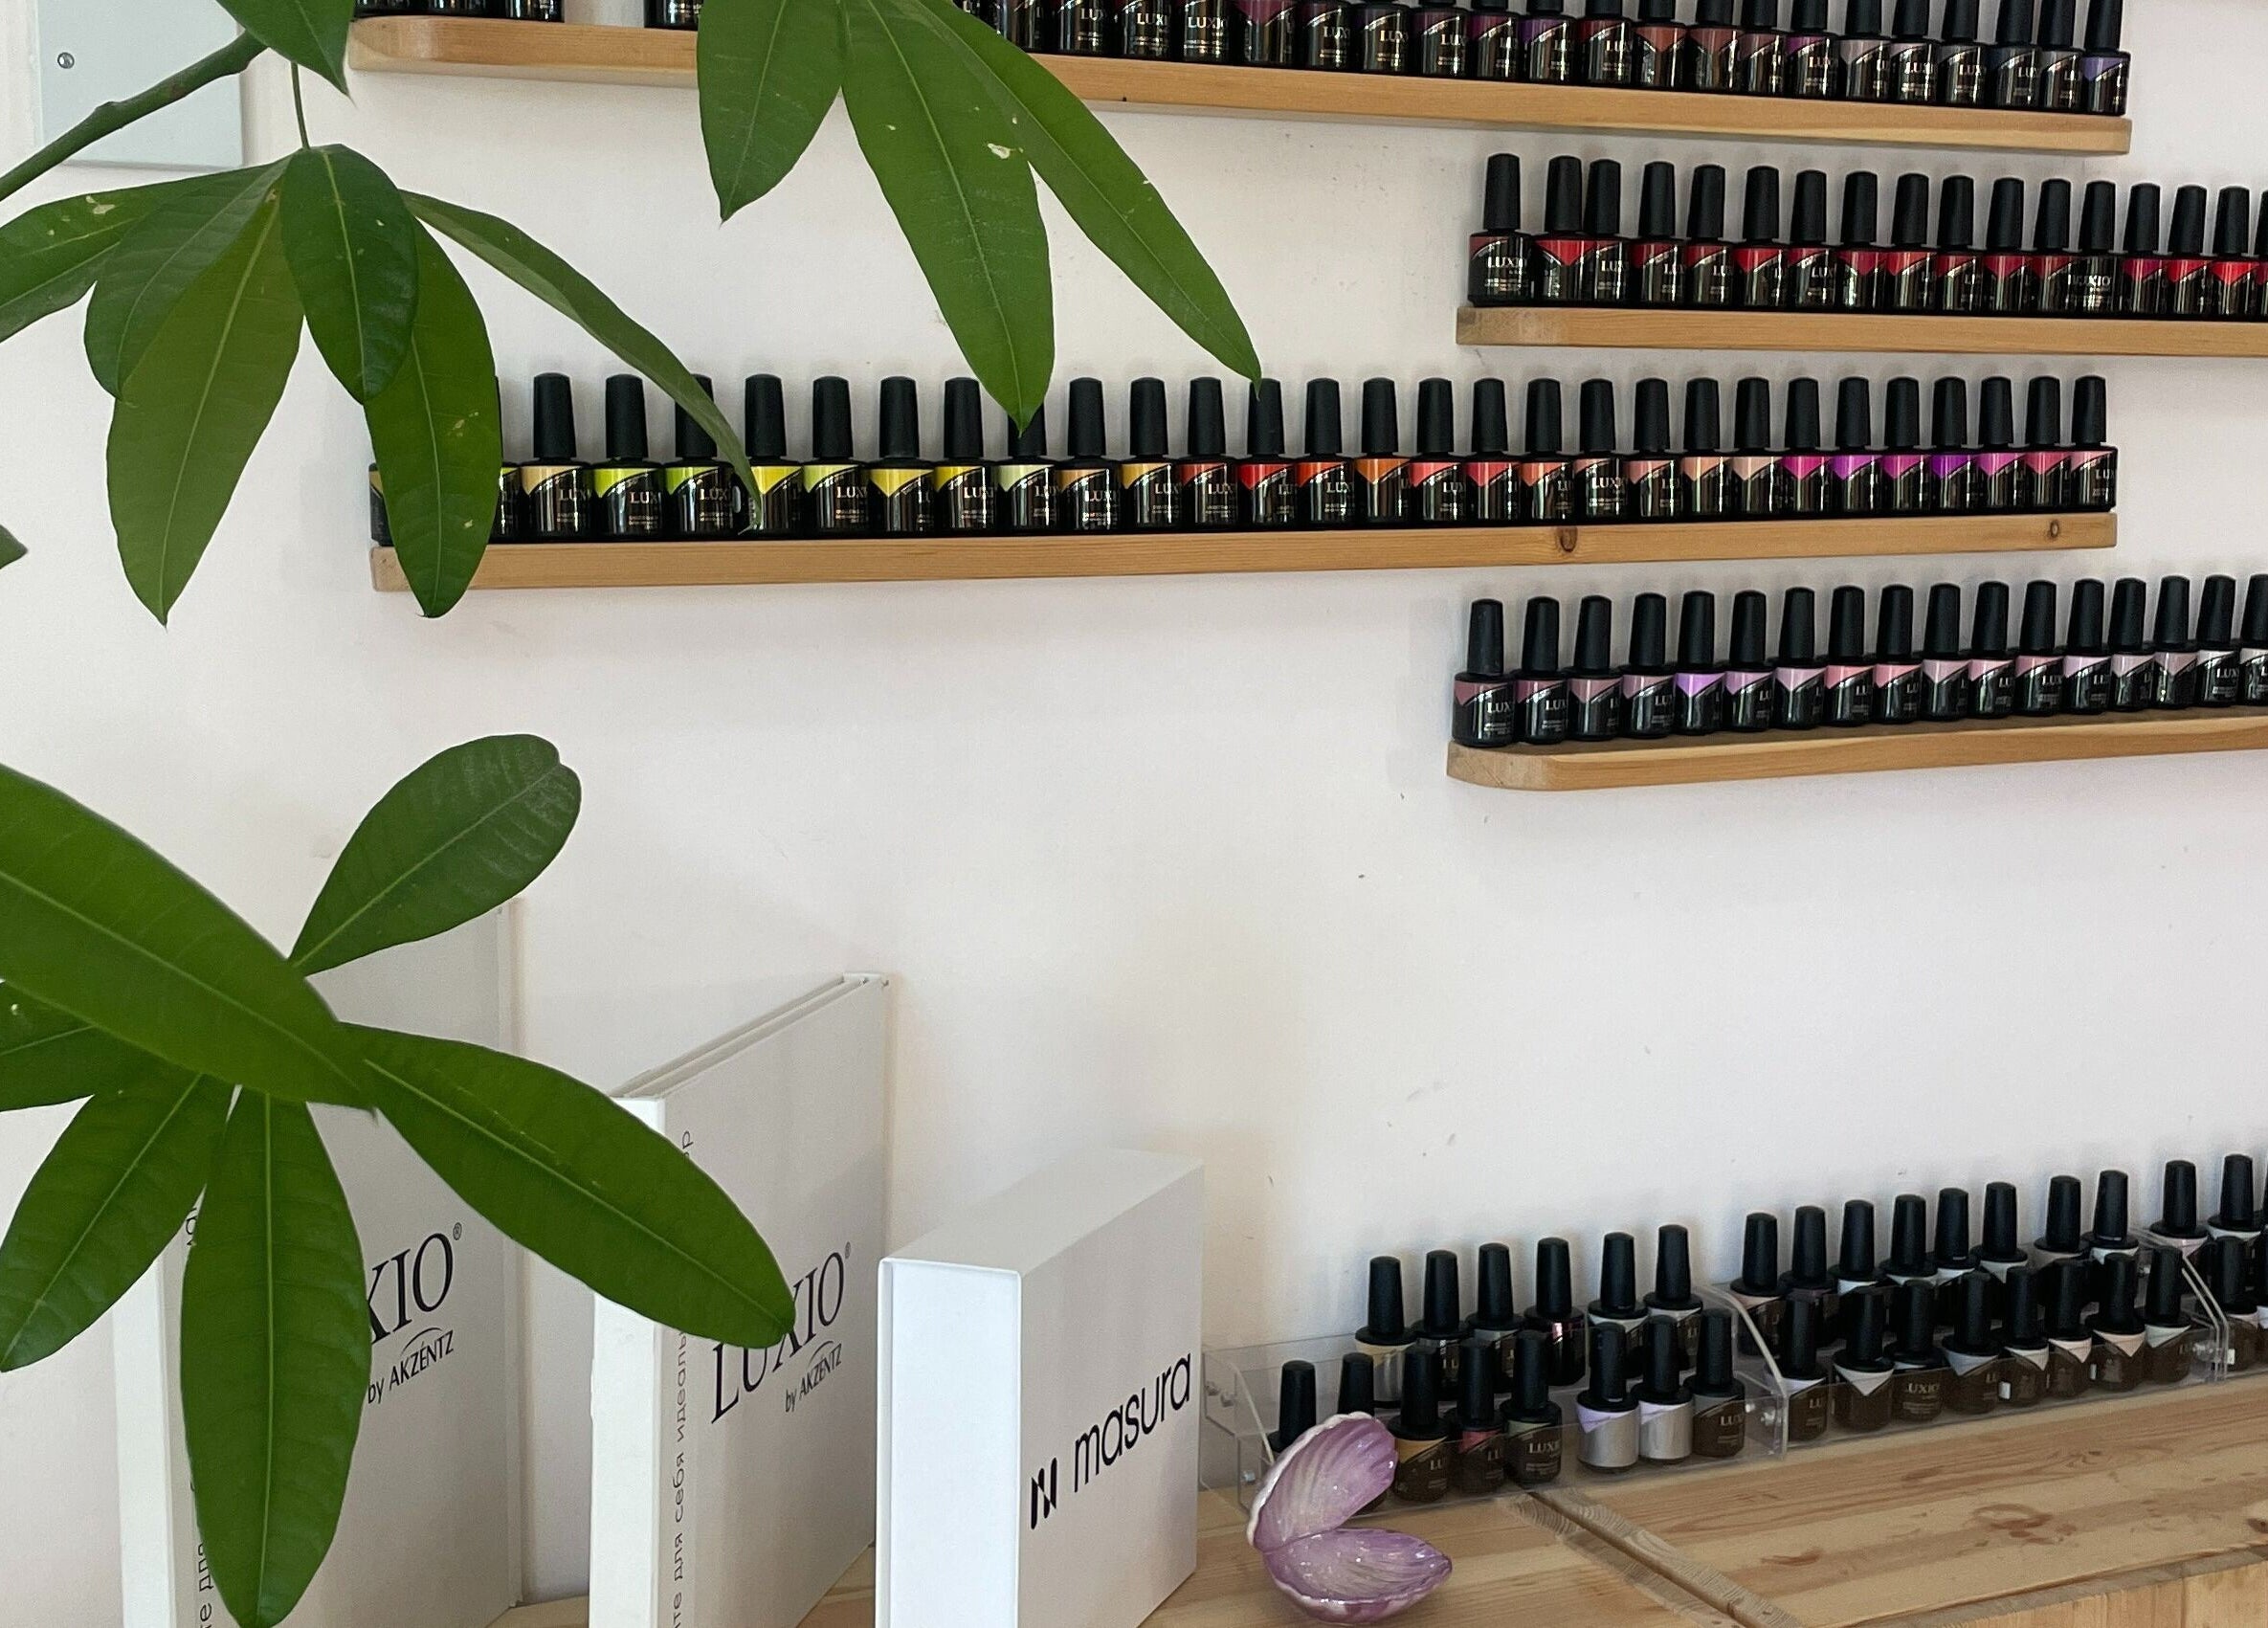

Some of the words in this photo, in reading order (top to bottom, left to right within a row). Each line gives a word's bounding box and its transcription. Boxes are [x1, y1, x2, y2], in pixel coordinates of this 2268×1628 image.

[677, 1330, 686, 1443] идеаль
[786, 1389, 797, 1413] by
[1074, 1352, 1191, 1493] masura
[673, 1452, 684, 1523] себя
[675, 1532, 683, 1581] для
